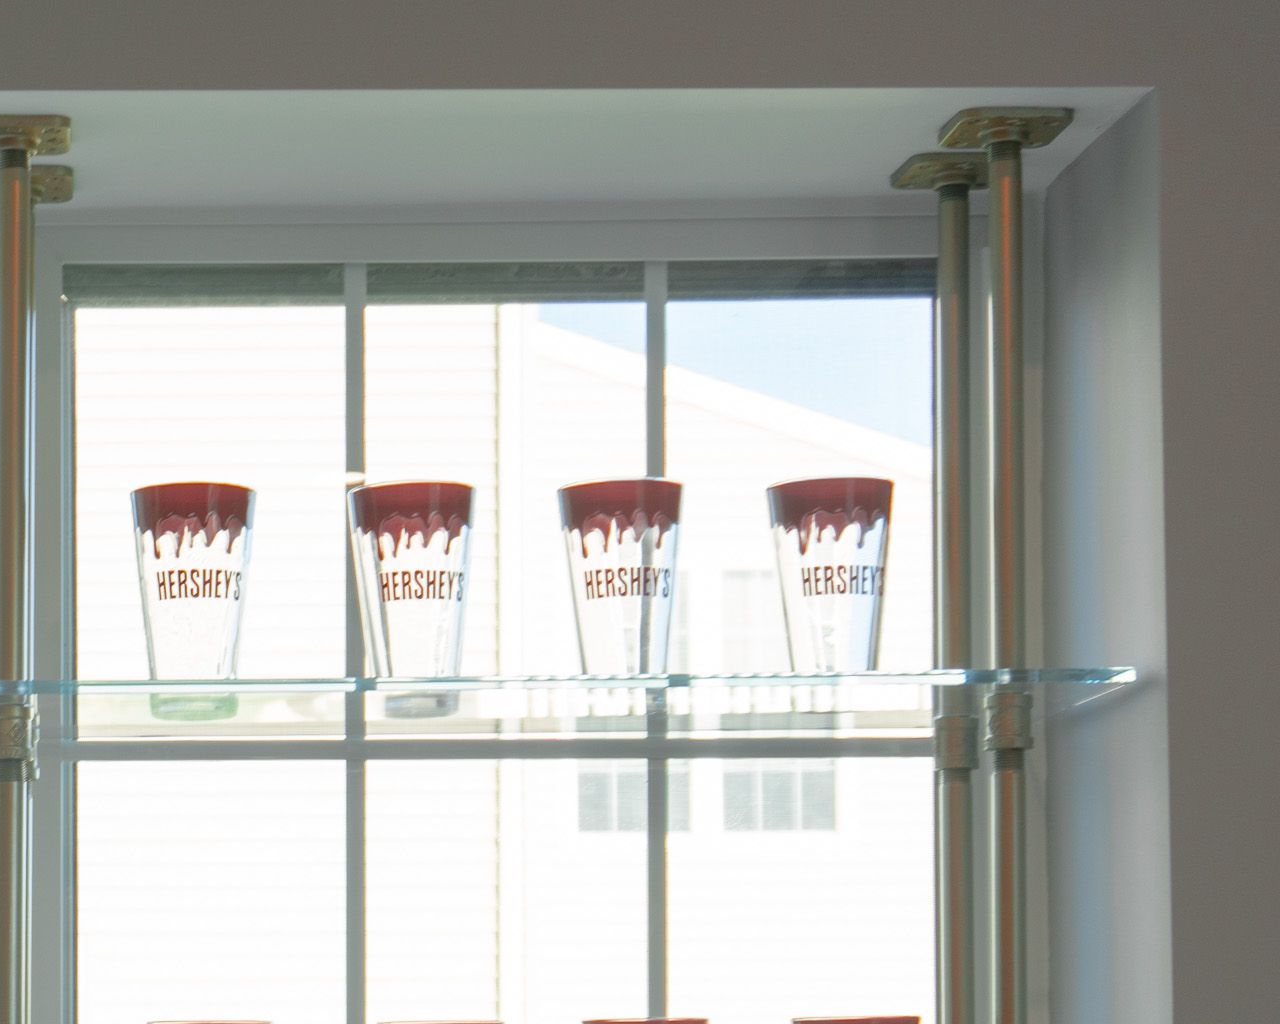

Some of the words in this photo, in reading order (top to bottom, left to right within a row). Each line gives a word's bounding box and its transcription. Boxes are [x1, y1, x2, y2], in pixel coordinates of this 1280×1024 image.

[157, 569, 242, 601] HERSHEY'S
[380, 570, 465, 602] HERSHEY'S
[584, 566, 671, 600] HERSHEY'S
